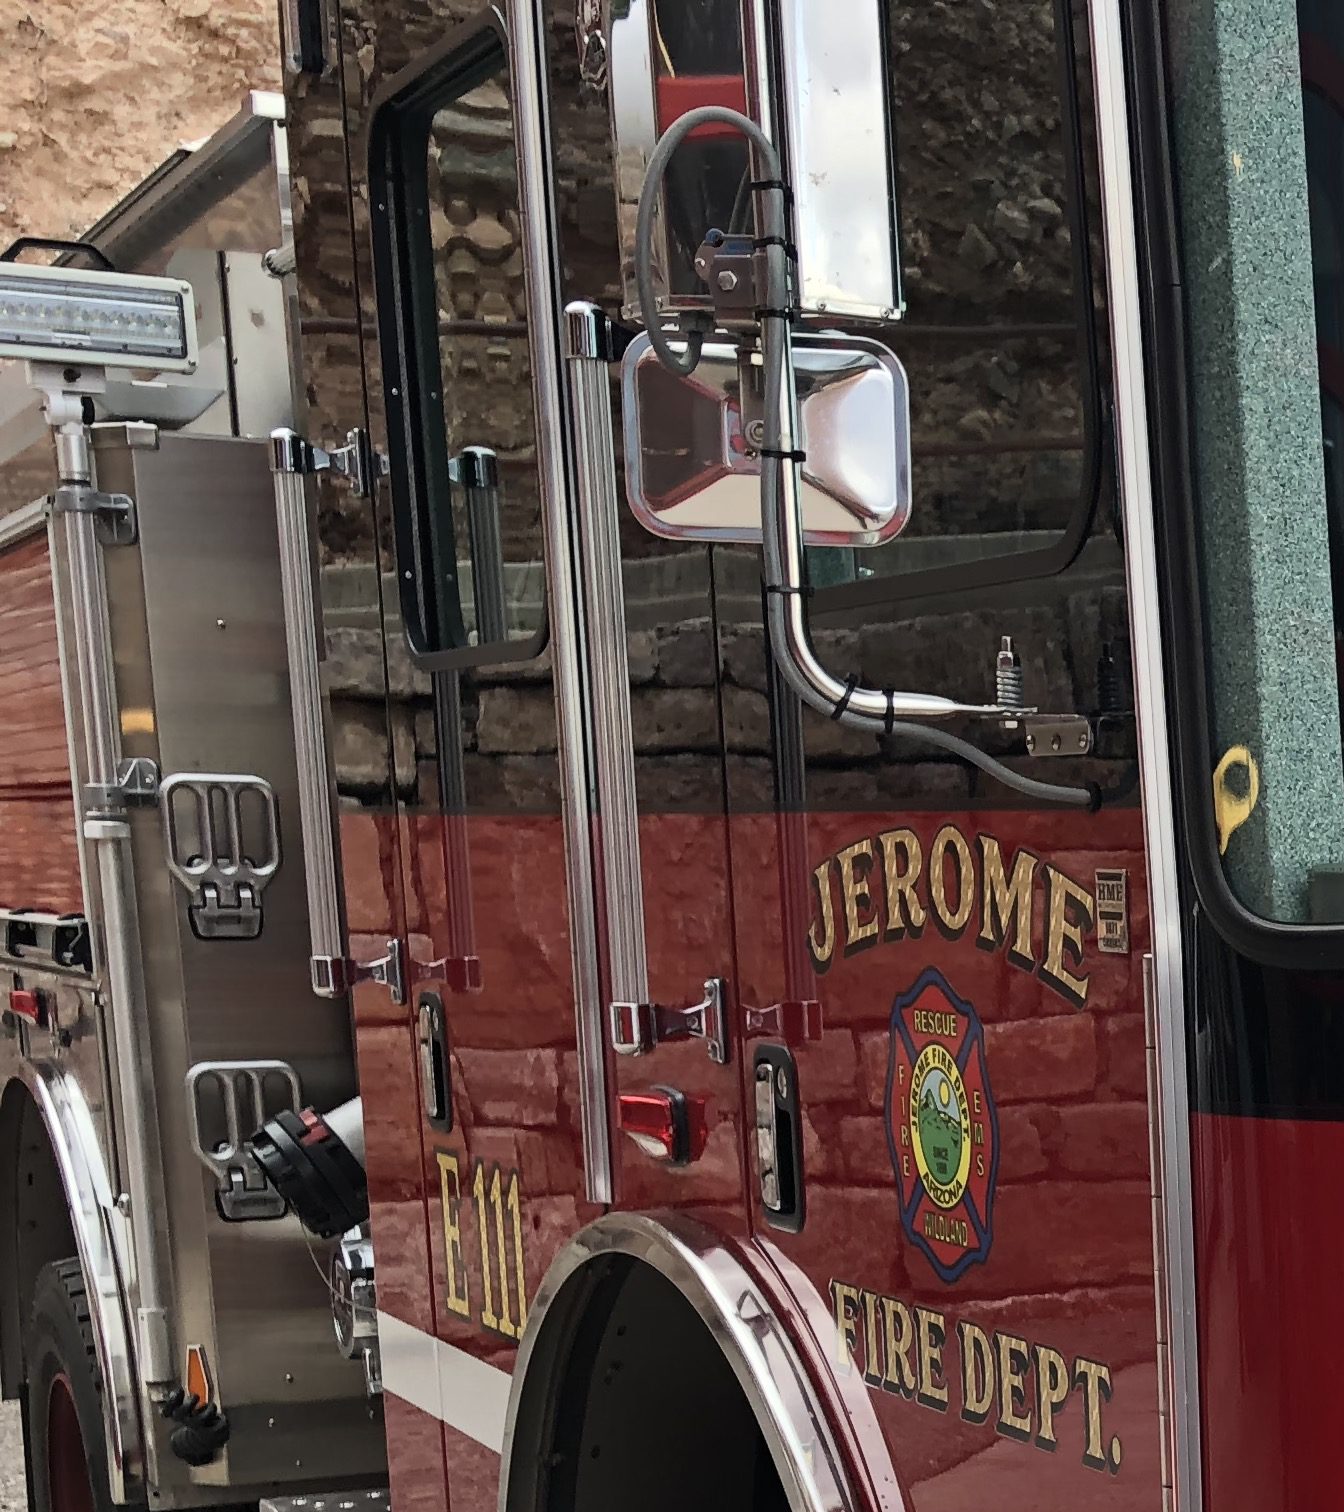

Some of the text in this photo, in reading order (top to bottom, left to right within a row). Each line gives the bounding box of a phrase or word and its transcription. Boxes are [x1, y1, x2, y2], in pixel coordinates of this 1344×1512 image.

[807, 824, 1095, 1005] JEROME
[914, 1010, 957, 1037] RESCUE
[931, 1047, 953, 1077] FIRE
[922, 1172, 963, 1205] ARIZONA
[434, 1150, 527, 1342] E 111
[924, 1211, 968, 1247] WILDLAND
[831, 1280, 1122, 1474] FIRE DEPT.
